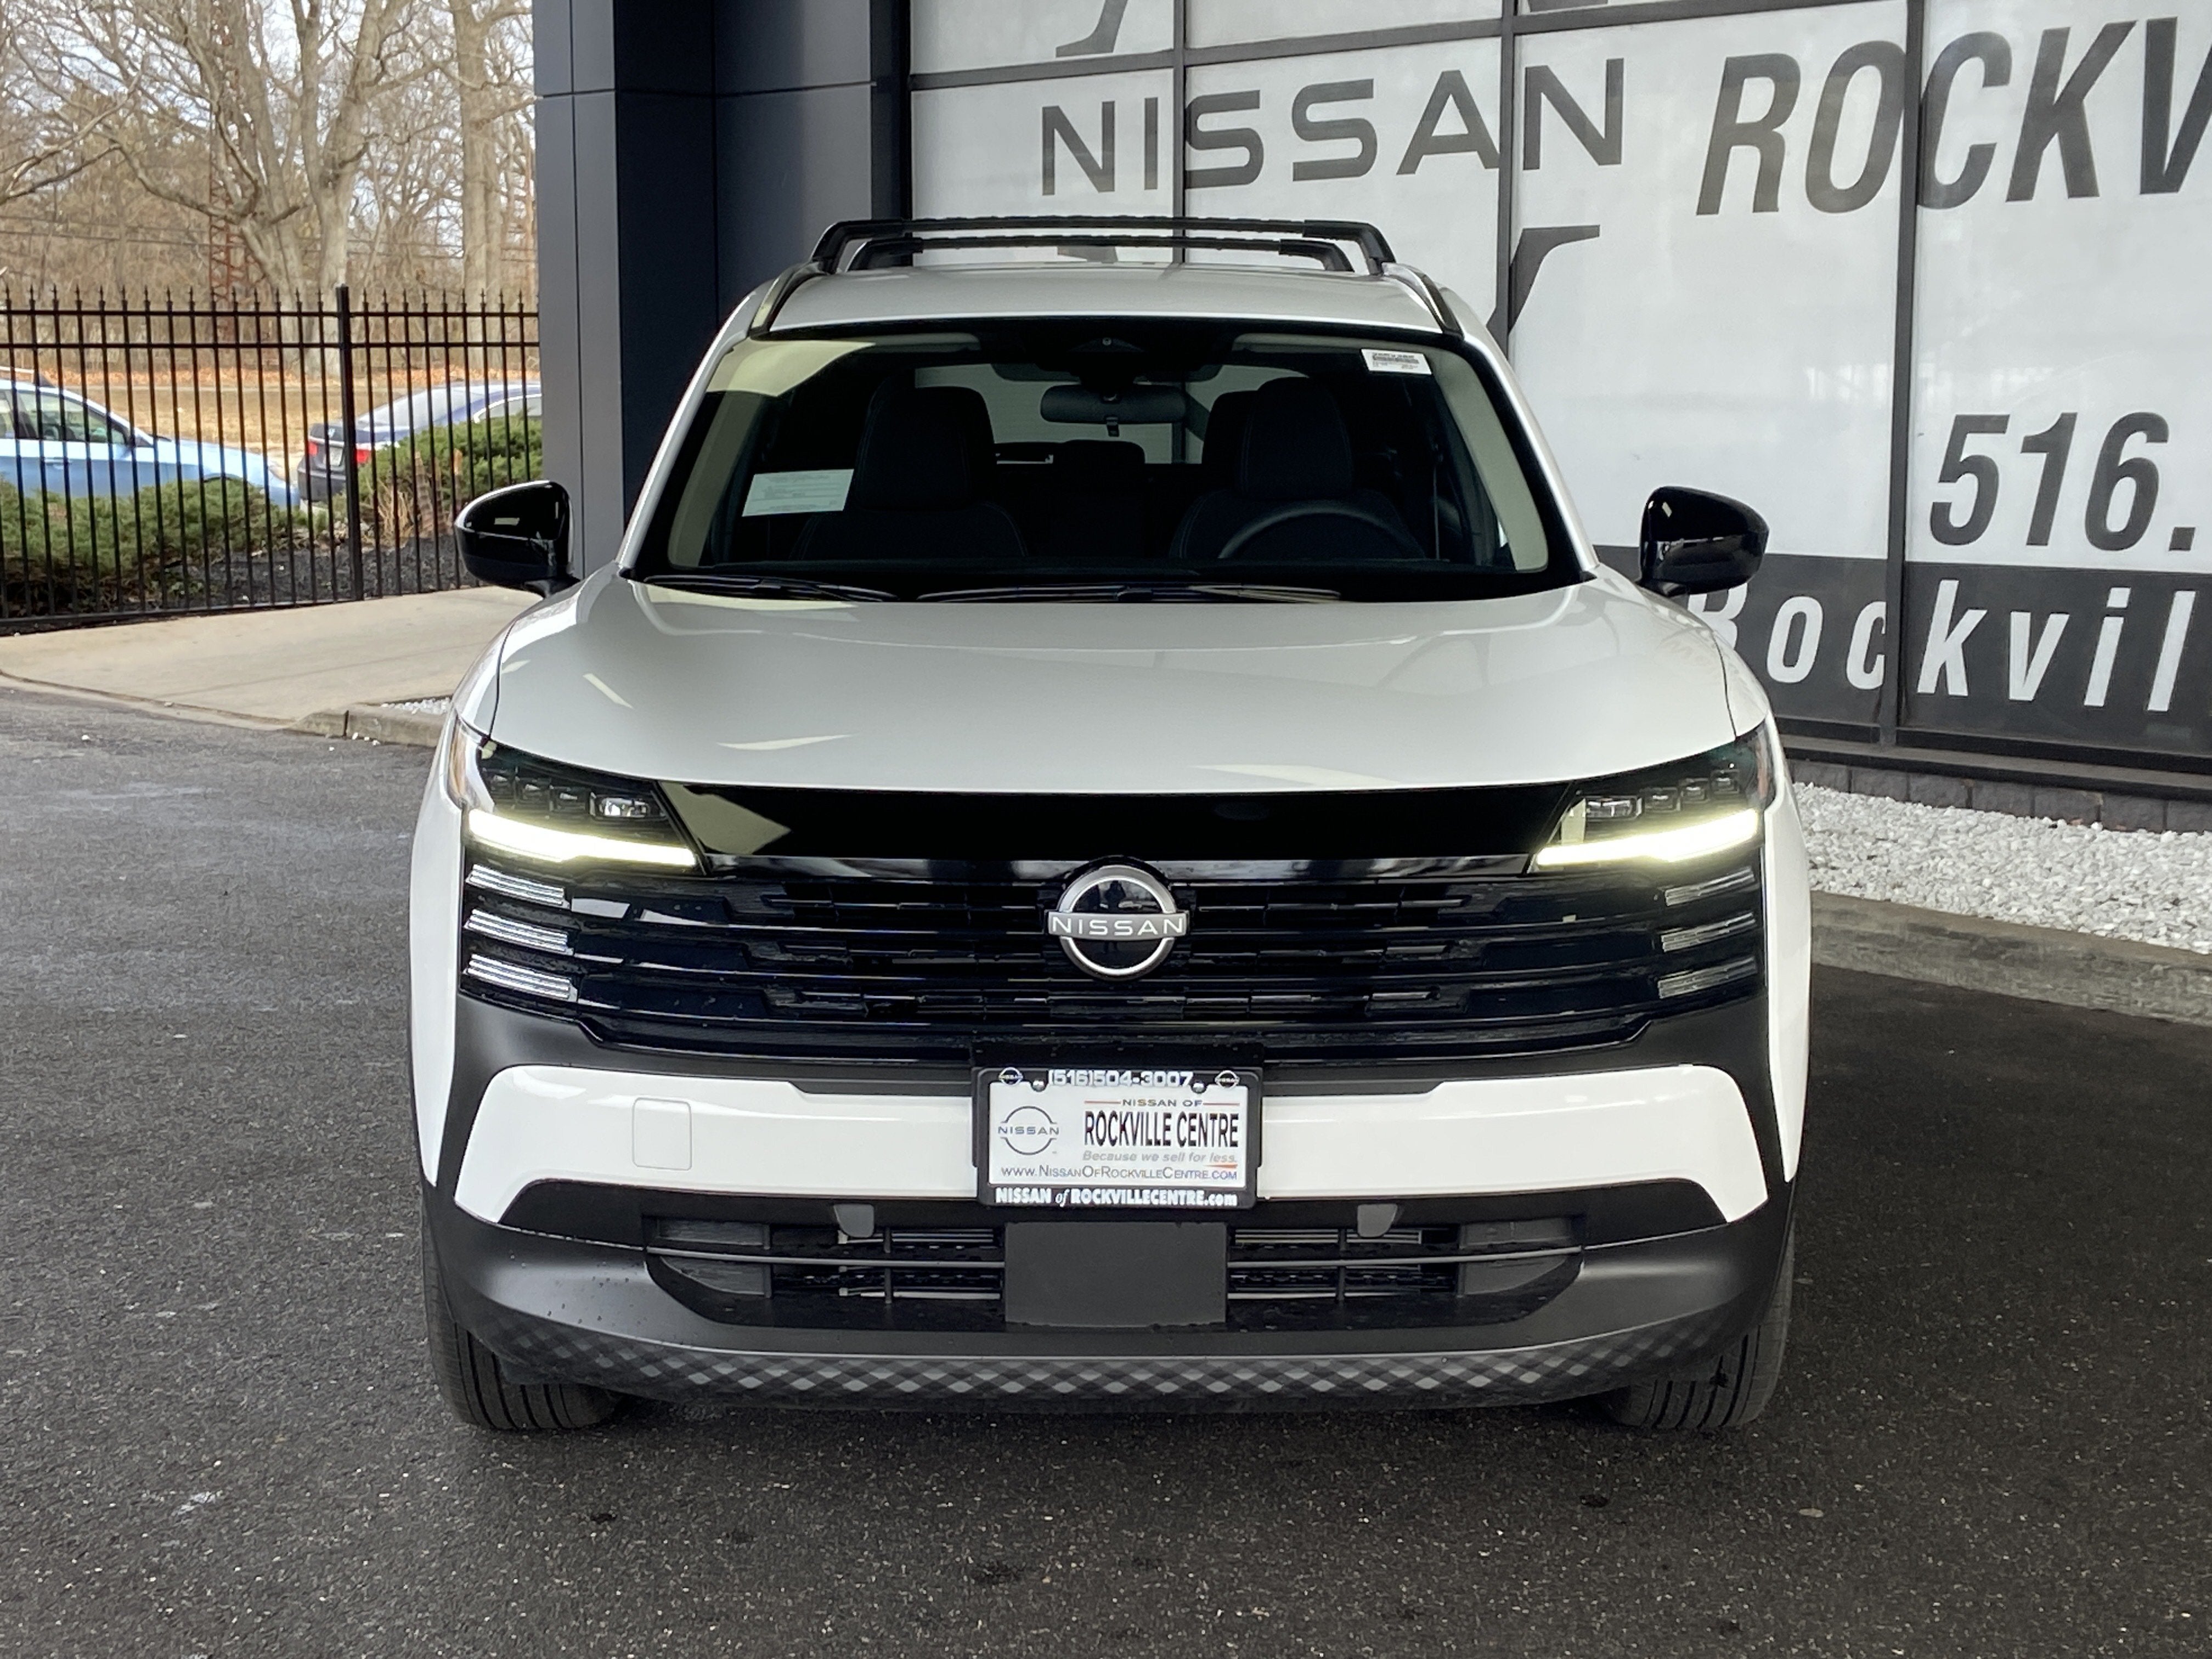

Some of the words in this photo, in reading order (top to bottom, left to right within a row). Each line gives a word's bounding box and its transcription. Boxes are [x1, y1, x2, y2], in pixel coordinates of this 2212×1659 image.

[1042, 58, 1624, 195] NISSAN
[1696, 16, 2212, 216] ROCKV
[1928, 411, 2196, 551] 516.
[1052, 916, 1183, 936] NISSAN
[1048, 1069, 1194, 1088] (516)504-3007
[1122, 1099, 1177, 1107] NISSAN
[997, 1125, 1059, 1135] NISSAN
[1084, 1110, 1171, 1148] ROCKVILLE
[1176, 1113, 1239, 1148] CENTRE
[1082, 1150, 1137, 1162] Because
[1141, 1153, 1159, 1162] we
[1162, 1152, 1185, 1162] sell
[1188, 1152, 1206, 1163] for
[1209, 1152, 1238, 1164] less.
[995, 1187, 1052, 1204] NISSAN
[1054, 1189, 1070, 1207] of
[1070, 1188, 1238, 1207] ROCKVILLECENTRE.com
